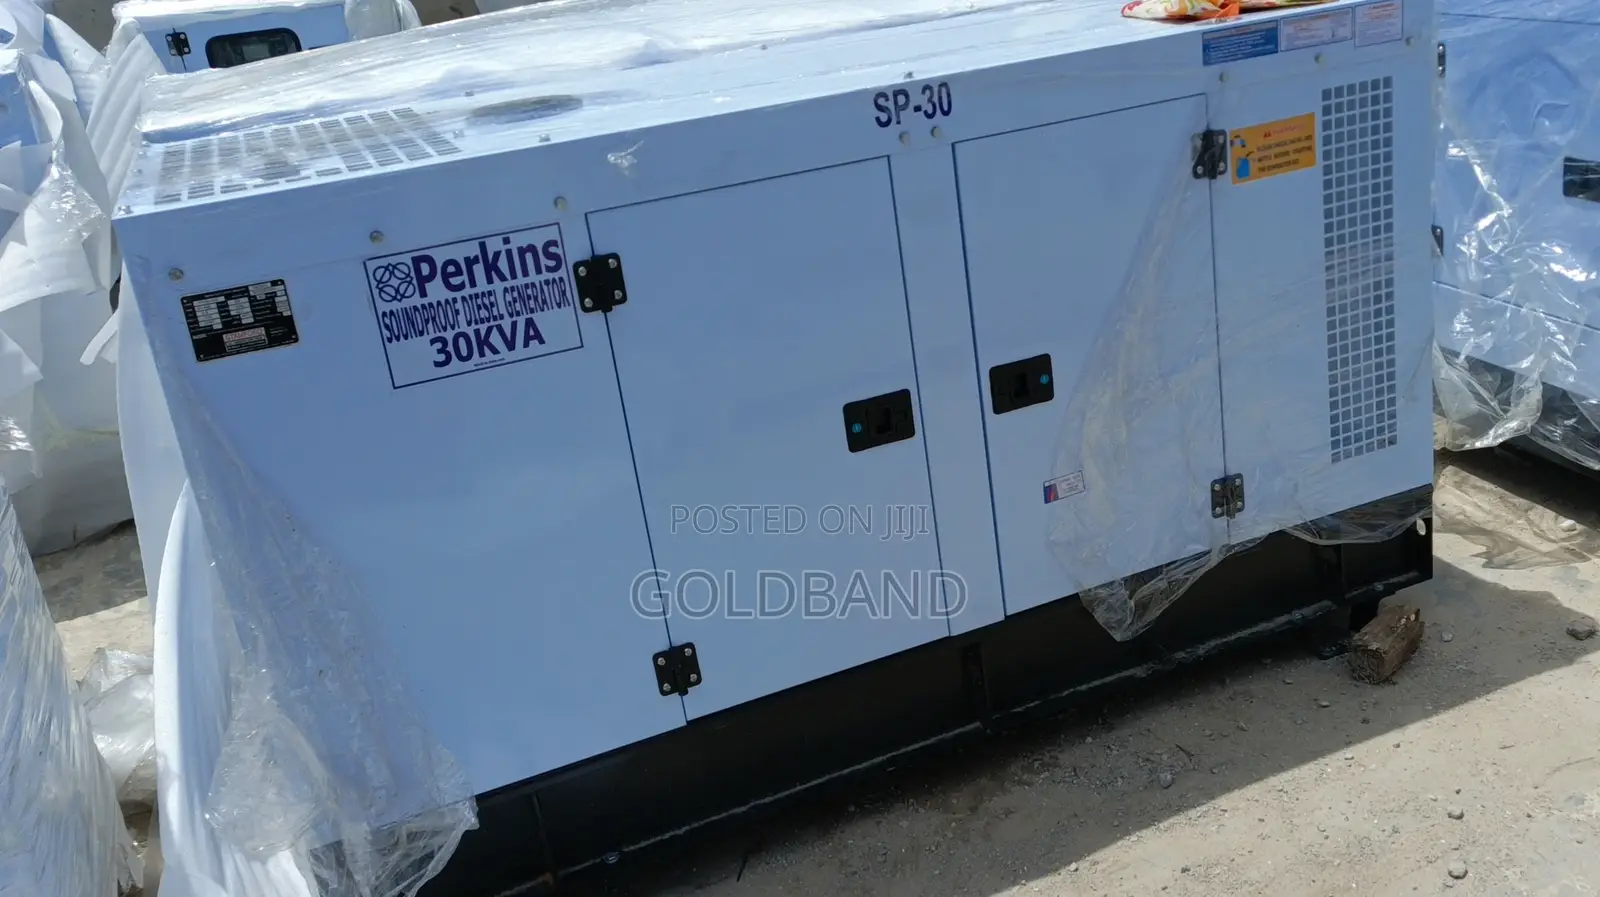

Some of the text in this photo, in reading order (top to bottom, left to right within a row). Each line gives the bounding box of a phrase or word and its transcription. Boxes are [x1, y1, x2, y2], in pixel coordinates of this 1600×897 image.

[873, 82, 952, 128] SP-30
[411, 236, 563, 299] Perkins
[381, 276, 571, 344] SOUNDPROOF DIESEL GENERATOR
[429, 317, 546, 368] 30KVA
